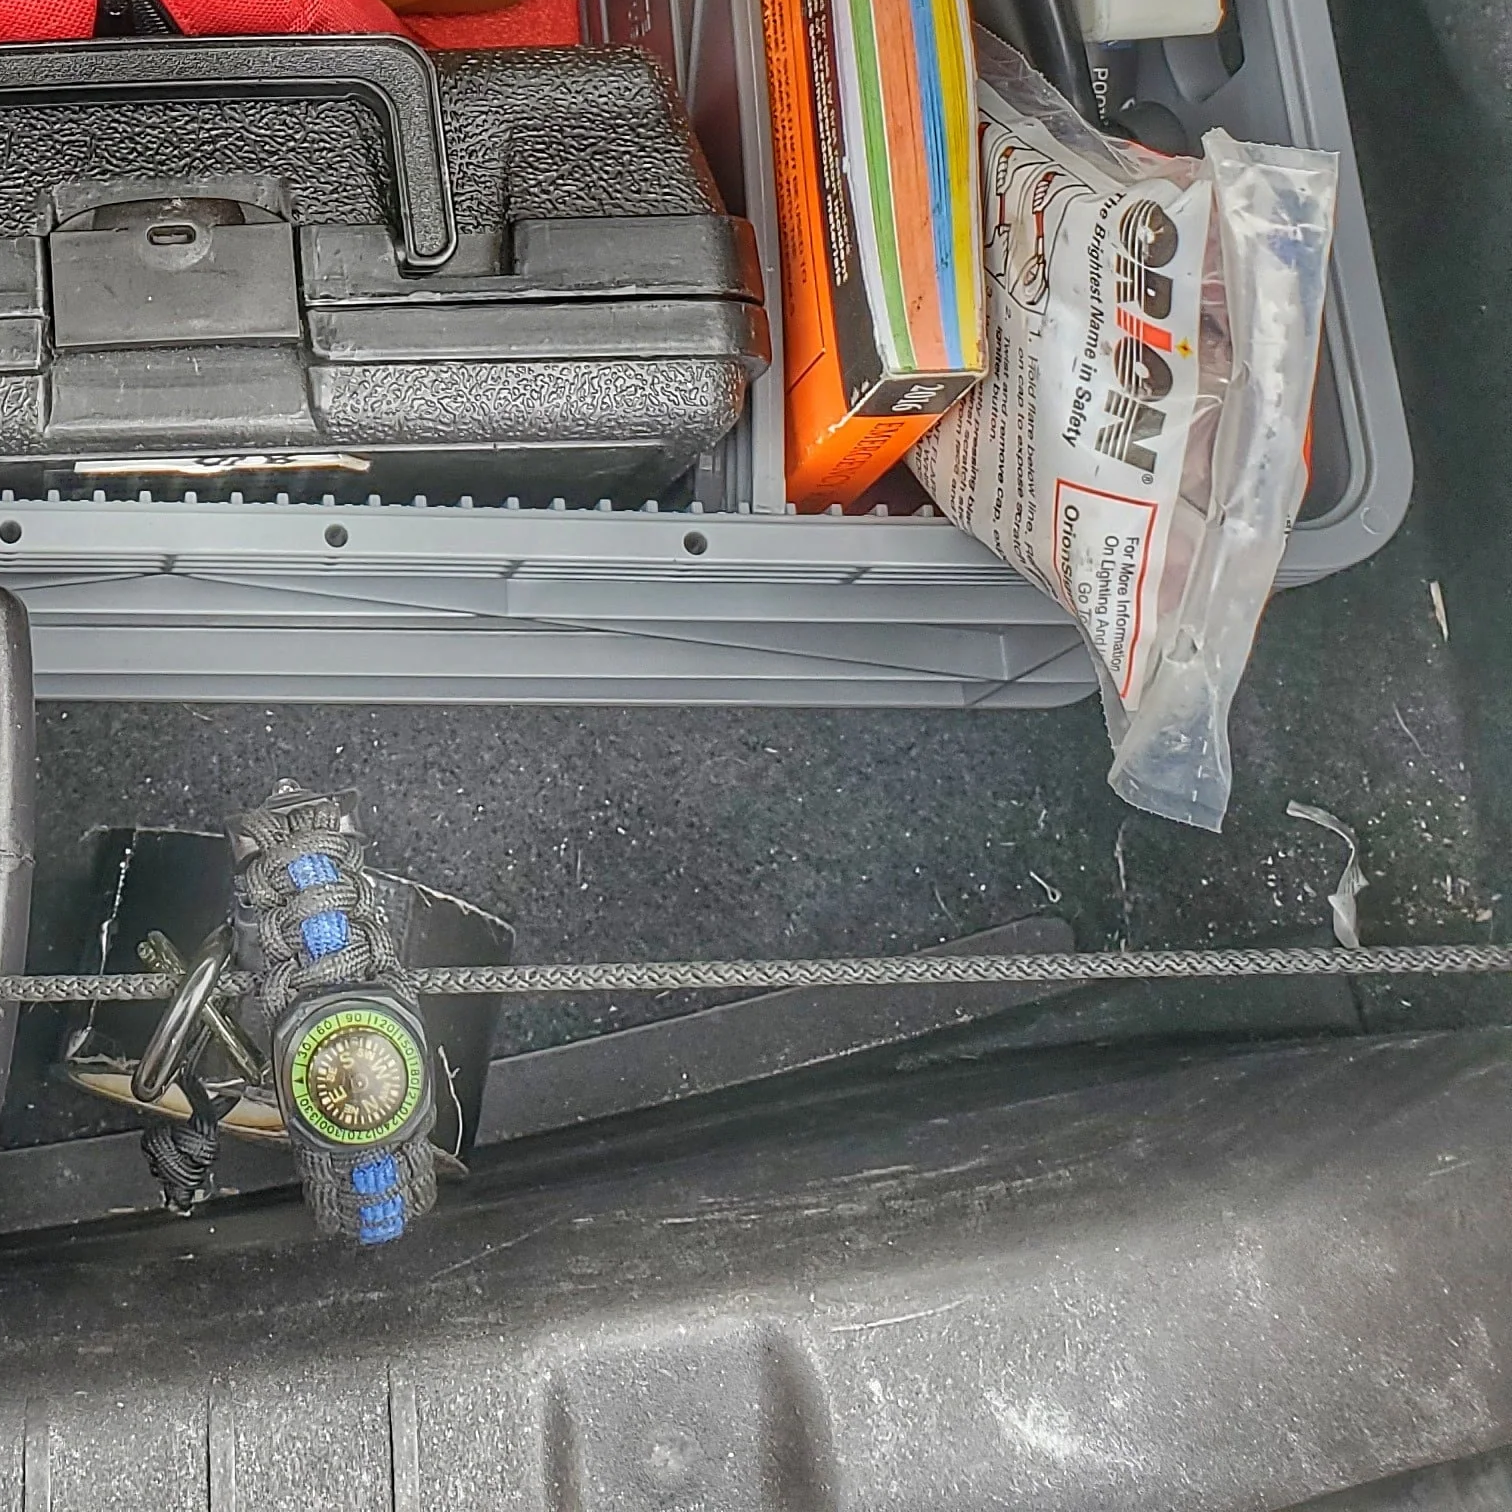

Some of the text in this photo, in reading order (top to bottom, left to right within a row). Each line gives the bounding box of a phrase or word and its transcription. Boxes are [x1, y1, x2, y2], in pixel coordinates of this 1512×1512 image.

[827, 81, 834, 105] by
[830, 109, 838, 148] first
[819, 55, 837, 194] transportation
[834, 199, 849, 282] incident
[834, 149, 852, 256] responders
[826, 194, 842, 287] materials
[1062, 191, 1127, 448] The Brightest Name in Safety
[1017, 347, 1025, 369] on
[1028, 354, 1039, 399] Hold
[891, 383, 945, 412] 2016
[1001, 382, 1010, 418] and
[1017, 374, 1025, 408] cap
[1017, 412, 1025, 431] to
[1027, 404, 1036, 441] flare
[959, 430, 970, 493] scratch
[968, 418, 981, 492] pressing
[998, 419, 1006, 484] remove
[1016, 434, 1024, 498] expose
[1027, 444, 1036, 498] below
[1102, 536, 1120, 556] On
[1078, 581, 1093, 605] Go
[1095, 560, 1115, 615] Lighting
[1111, 536, 1140, 672] For More Information
[1095, 618, 1110, 652] And
[316, 1020, 332, 1035] 60
[345, 1013, 362, 1023] 90
[373, 1016, 395, 1034] 120
[298, 1042, 312, 1059] 30
[397, 1033, 414, 1056] 150
[340, 1051, 354, 1069] S
[410, 1060, 420, 1088] 180
[300, 1098, 319, 1118] 330
[328, 1085, 348, 1103] E
[399, 1091, 416, 1114] 210
[319, 1120, 341, 1137] 300
[347, 1129, 373, 1141] 270
[377, 1114, 399, 1135] 240
